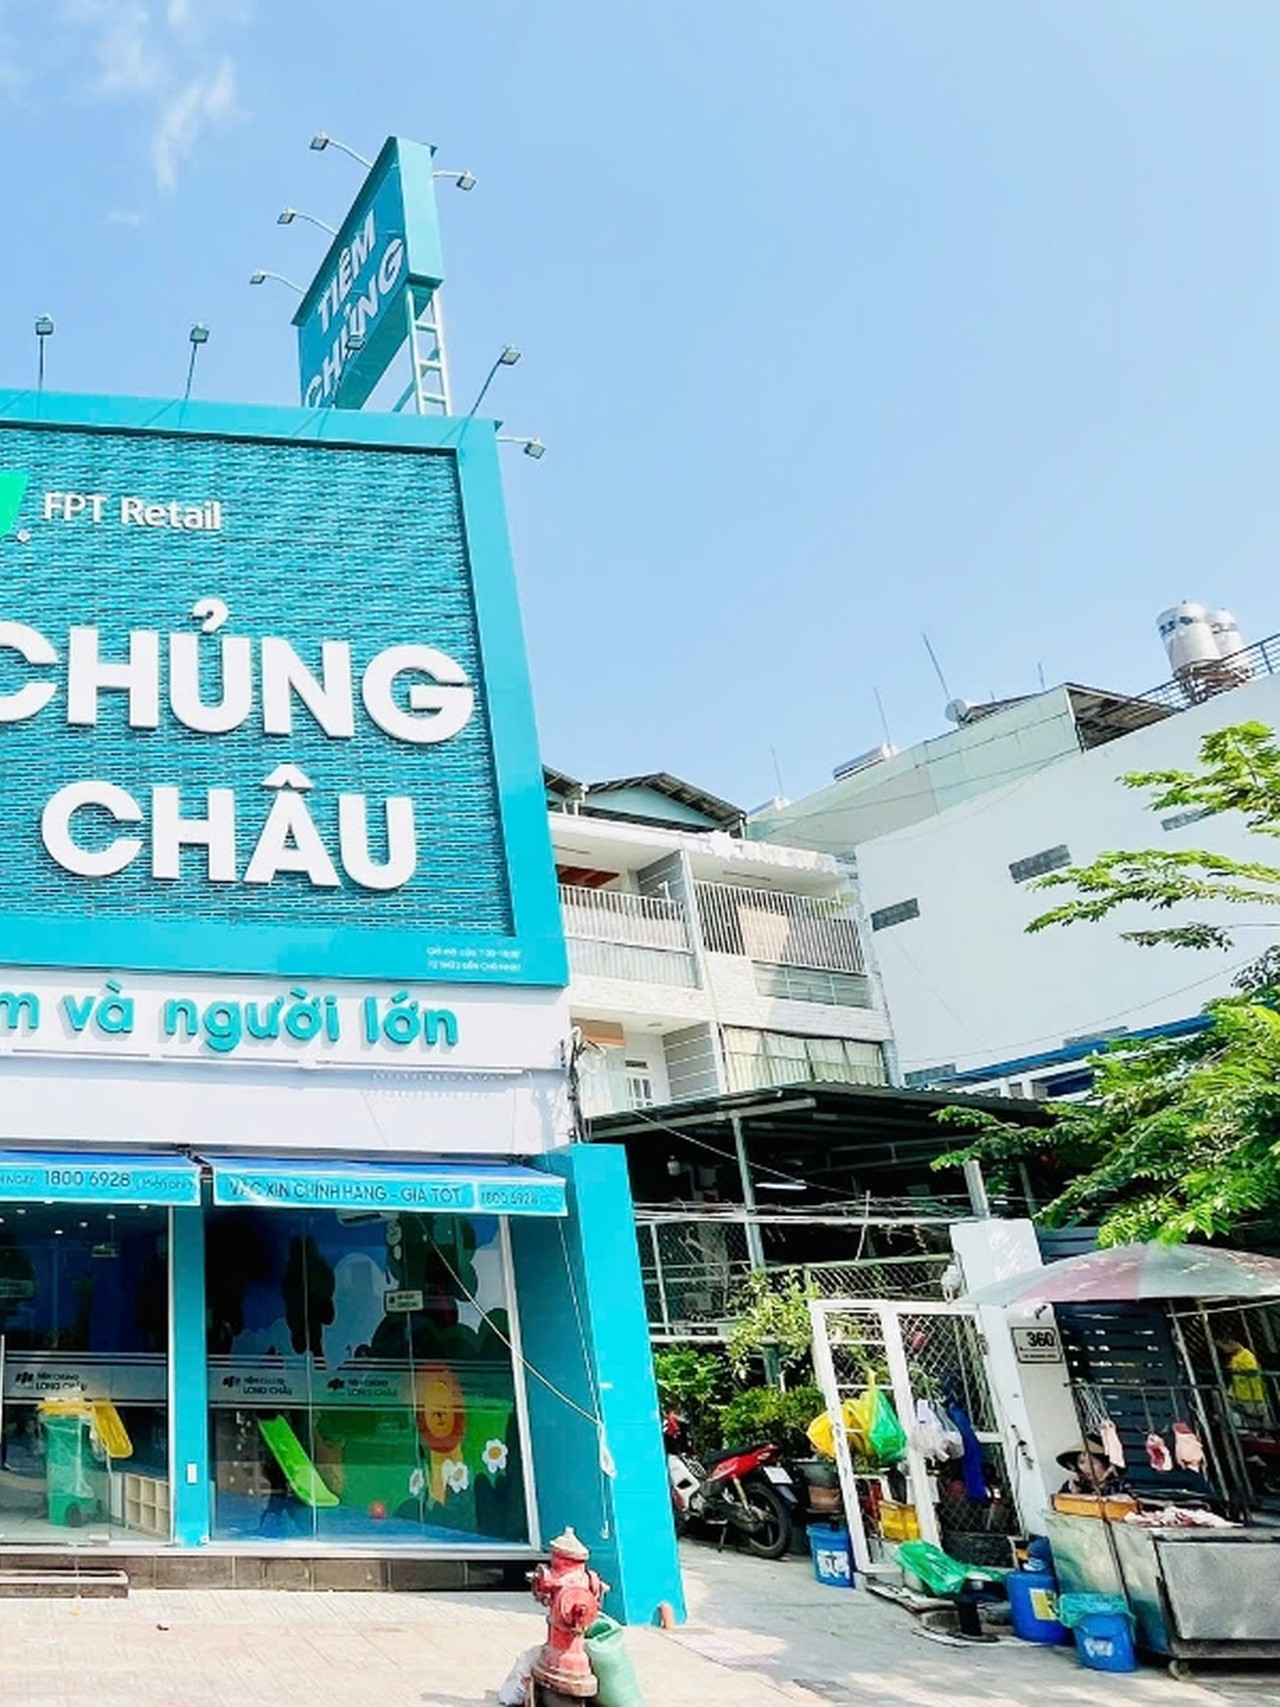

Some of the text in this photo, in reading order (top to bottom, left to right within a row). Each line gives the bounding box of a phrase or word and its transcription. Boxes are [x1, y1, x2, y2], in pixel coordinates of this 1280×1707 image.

[42, 491, 221, 531] FPT Retail
[40, 764, 418, 892] CHÂU
[63, 980, 136, 1035] và
[163, 986, 341, 1054] người
[364, 989, 460, 1047] lớn
[45, 1169, 84, 1186] 1800
[89, 1171, 131, 1188] 6928
[1026, 1331, 1055, 1347] 360
